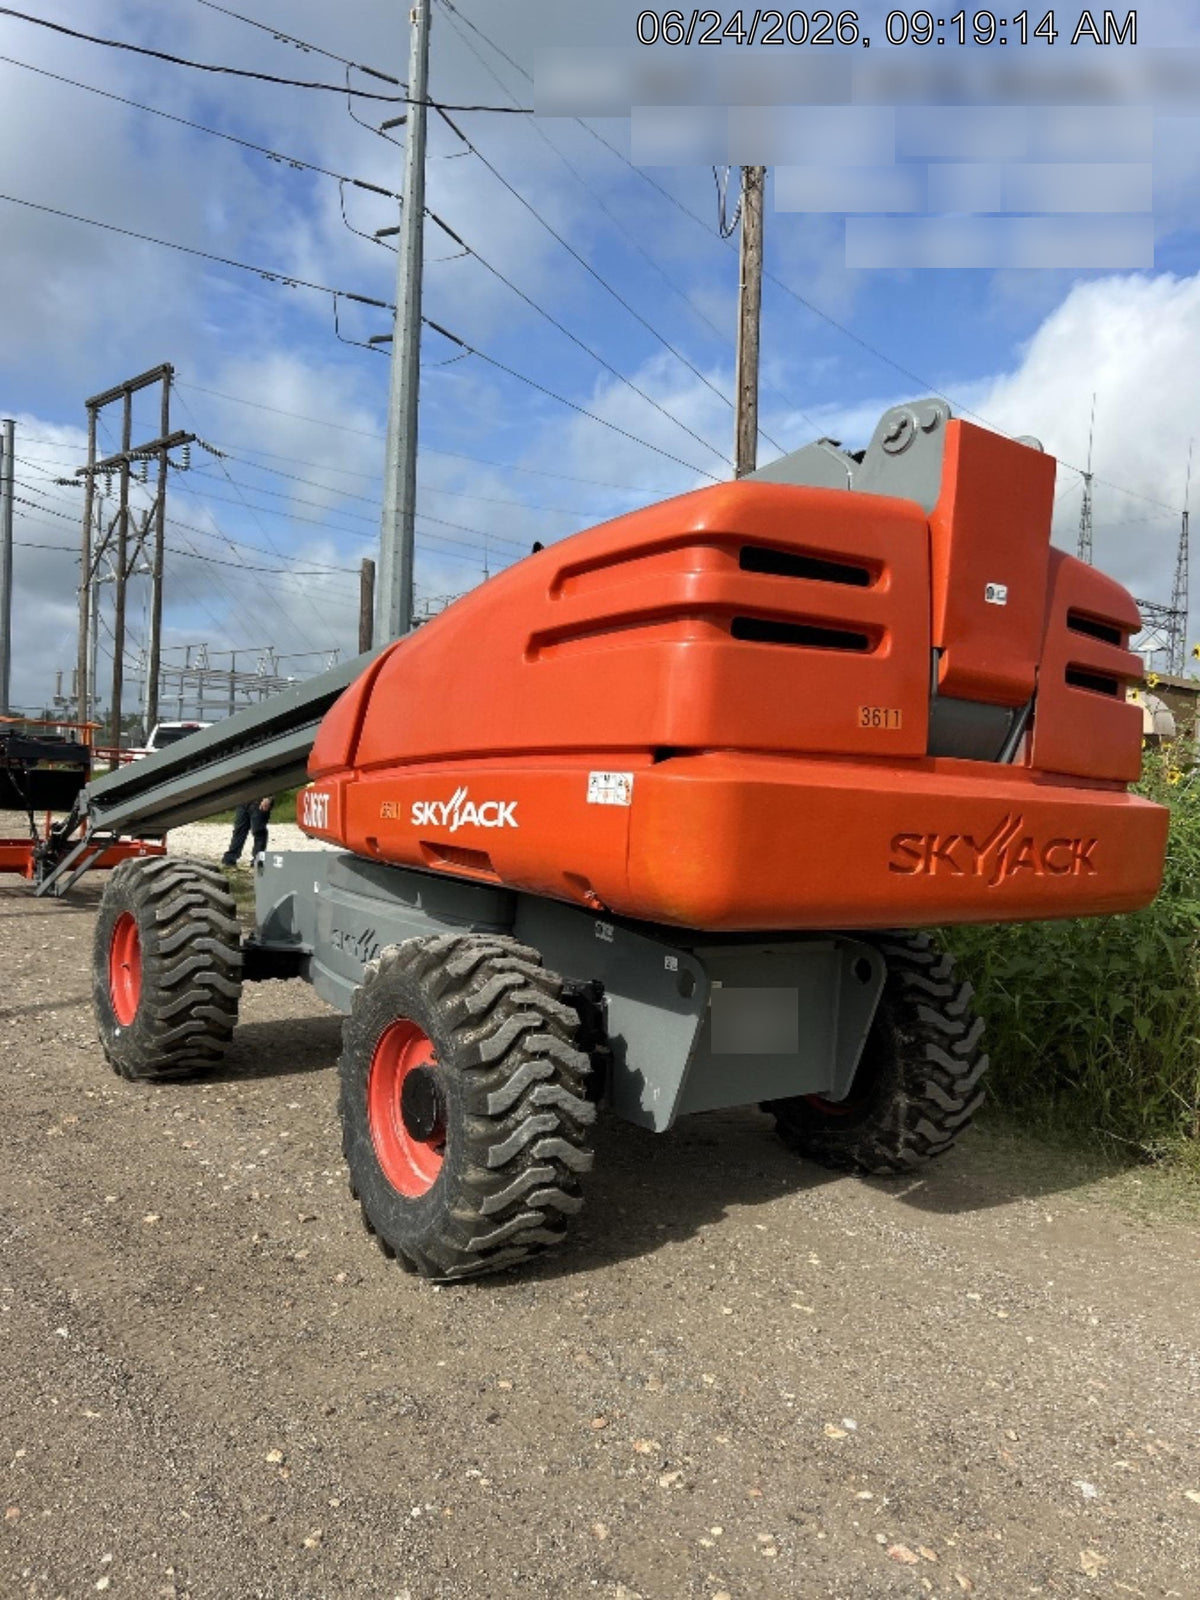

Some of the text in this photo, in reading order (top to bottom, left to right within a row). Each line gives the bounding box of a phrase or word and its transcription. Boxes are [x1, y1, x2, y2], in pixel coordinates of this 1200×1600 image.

[862, 706, 899, 728] 3611
[411, 785, 519, 832] SKYJACK
[888, 812, 1098, 888] SKYJACK
